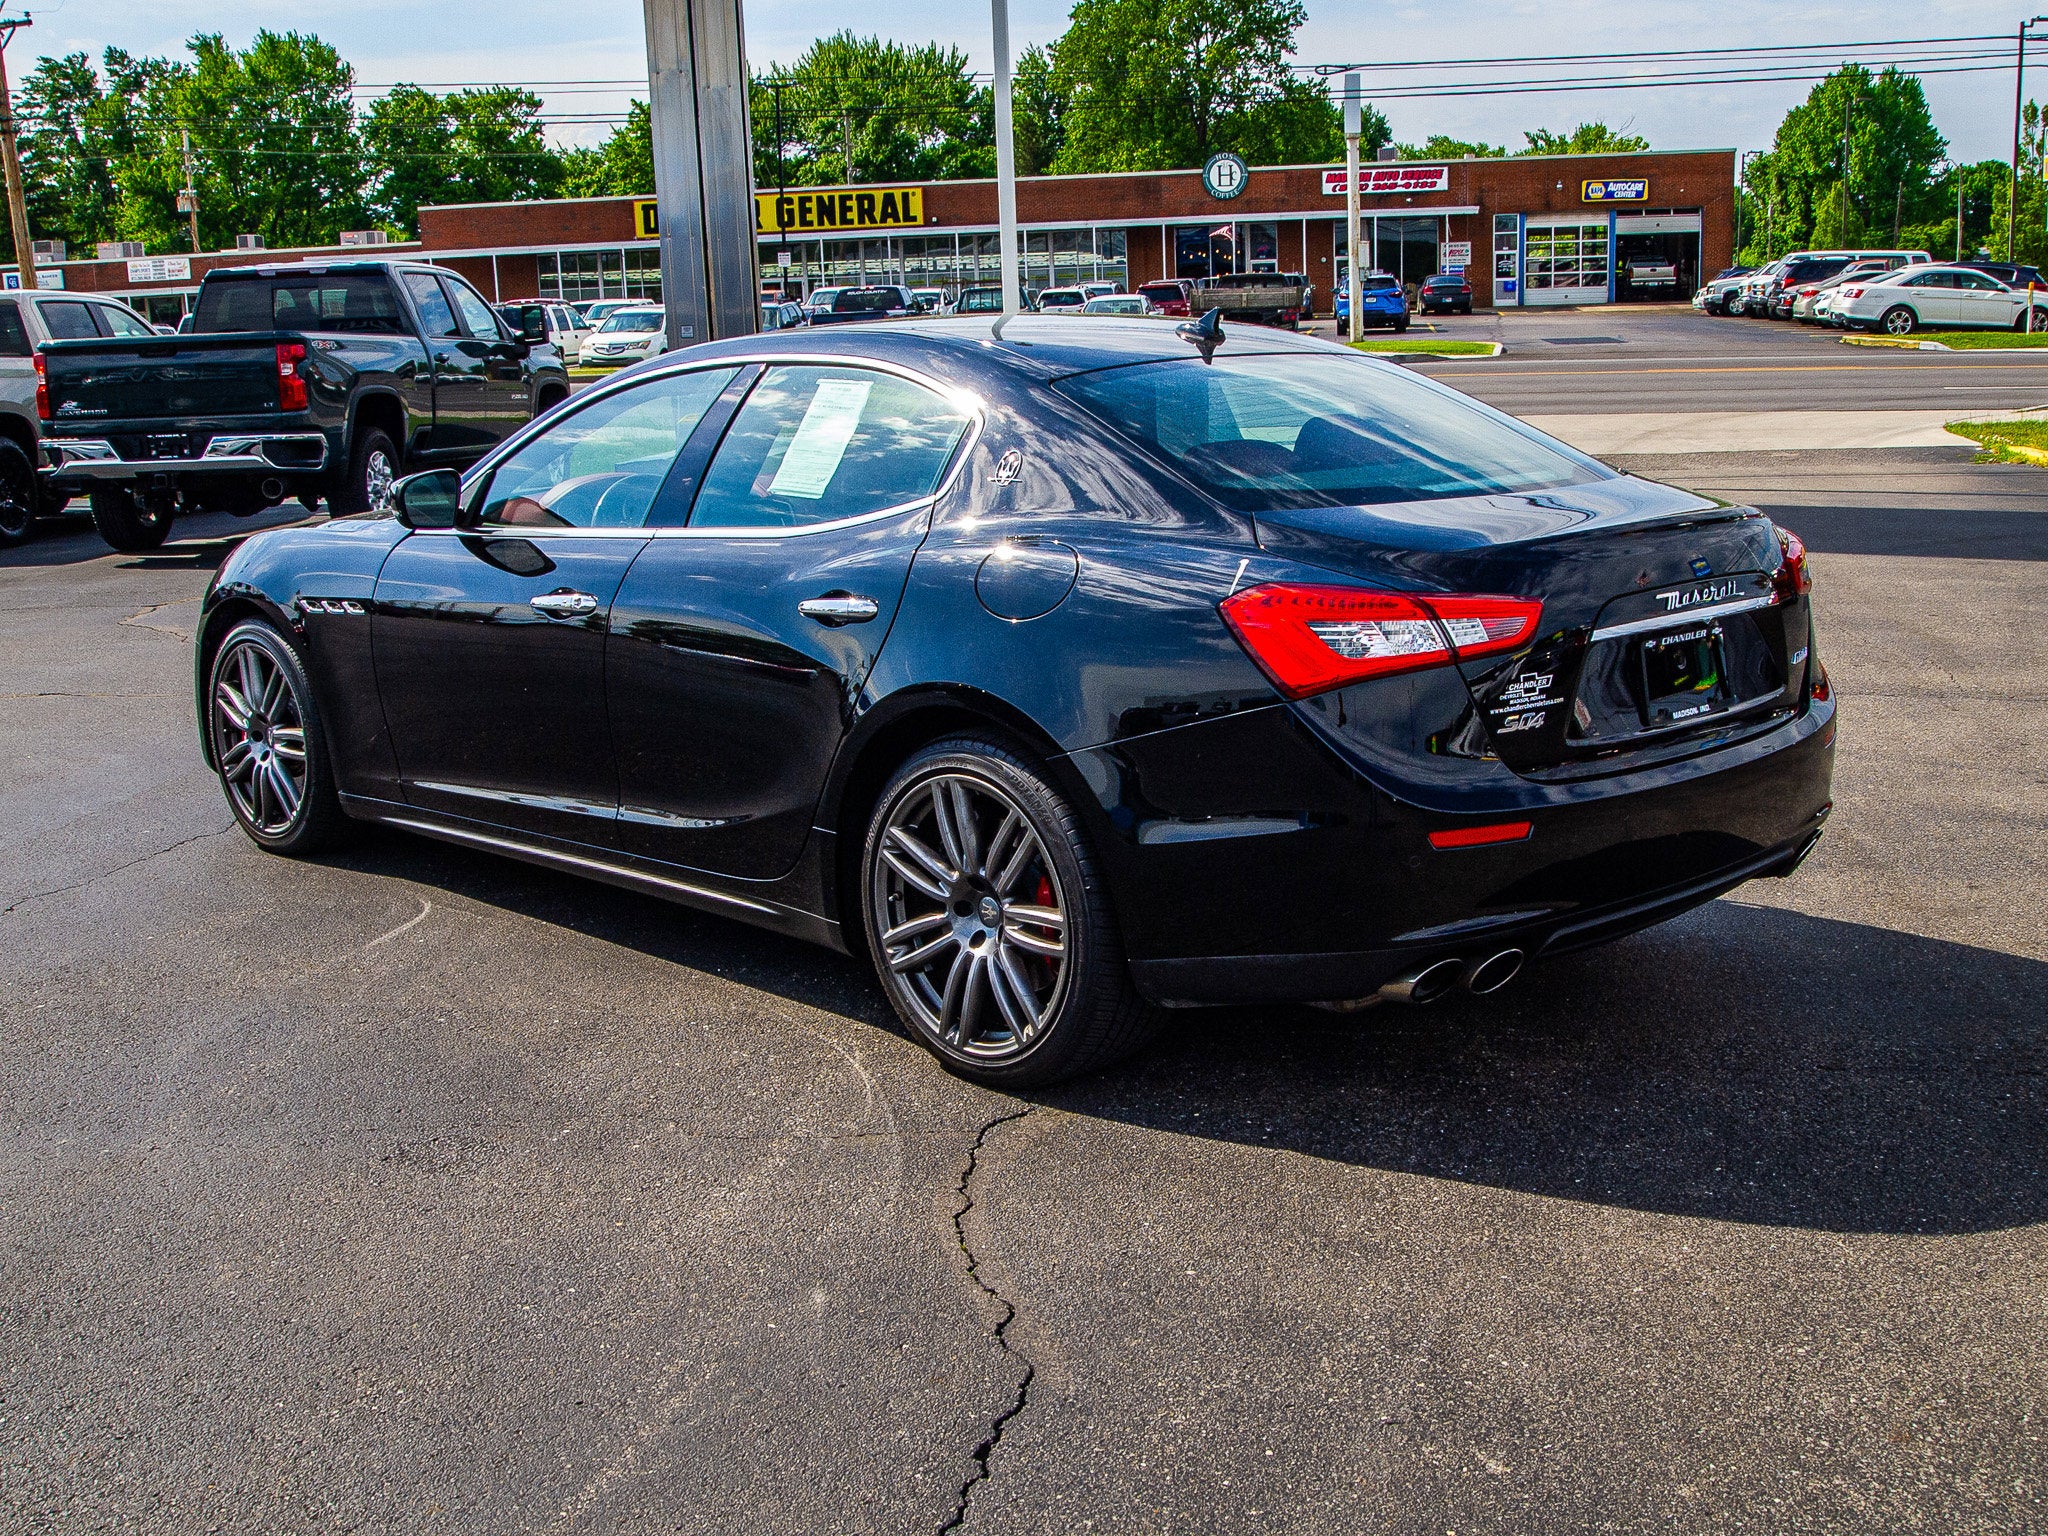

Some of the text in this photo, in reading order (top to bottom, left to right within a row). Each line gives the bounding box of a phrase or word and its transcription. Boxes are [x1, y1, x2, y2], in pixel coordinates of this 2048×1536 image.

[1215, 152, 1234, 160] HOS
[1373, 170, 1400, 182] AUTO
[1400, 168, 1444, 181] SERVICE
[1211, 189, 1240, 199] COFFEE
[1614, 190, 1636, 198] CENTER
[775, 191, 918, 229] GENERAL
[1661, 629, 1707, 646] CHANDLER
[1508, 679, 1548, 691] CHANDLER
